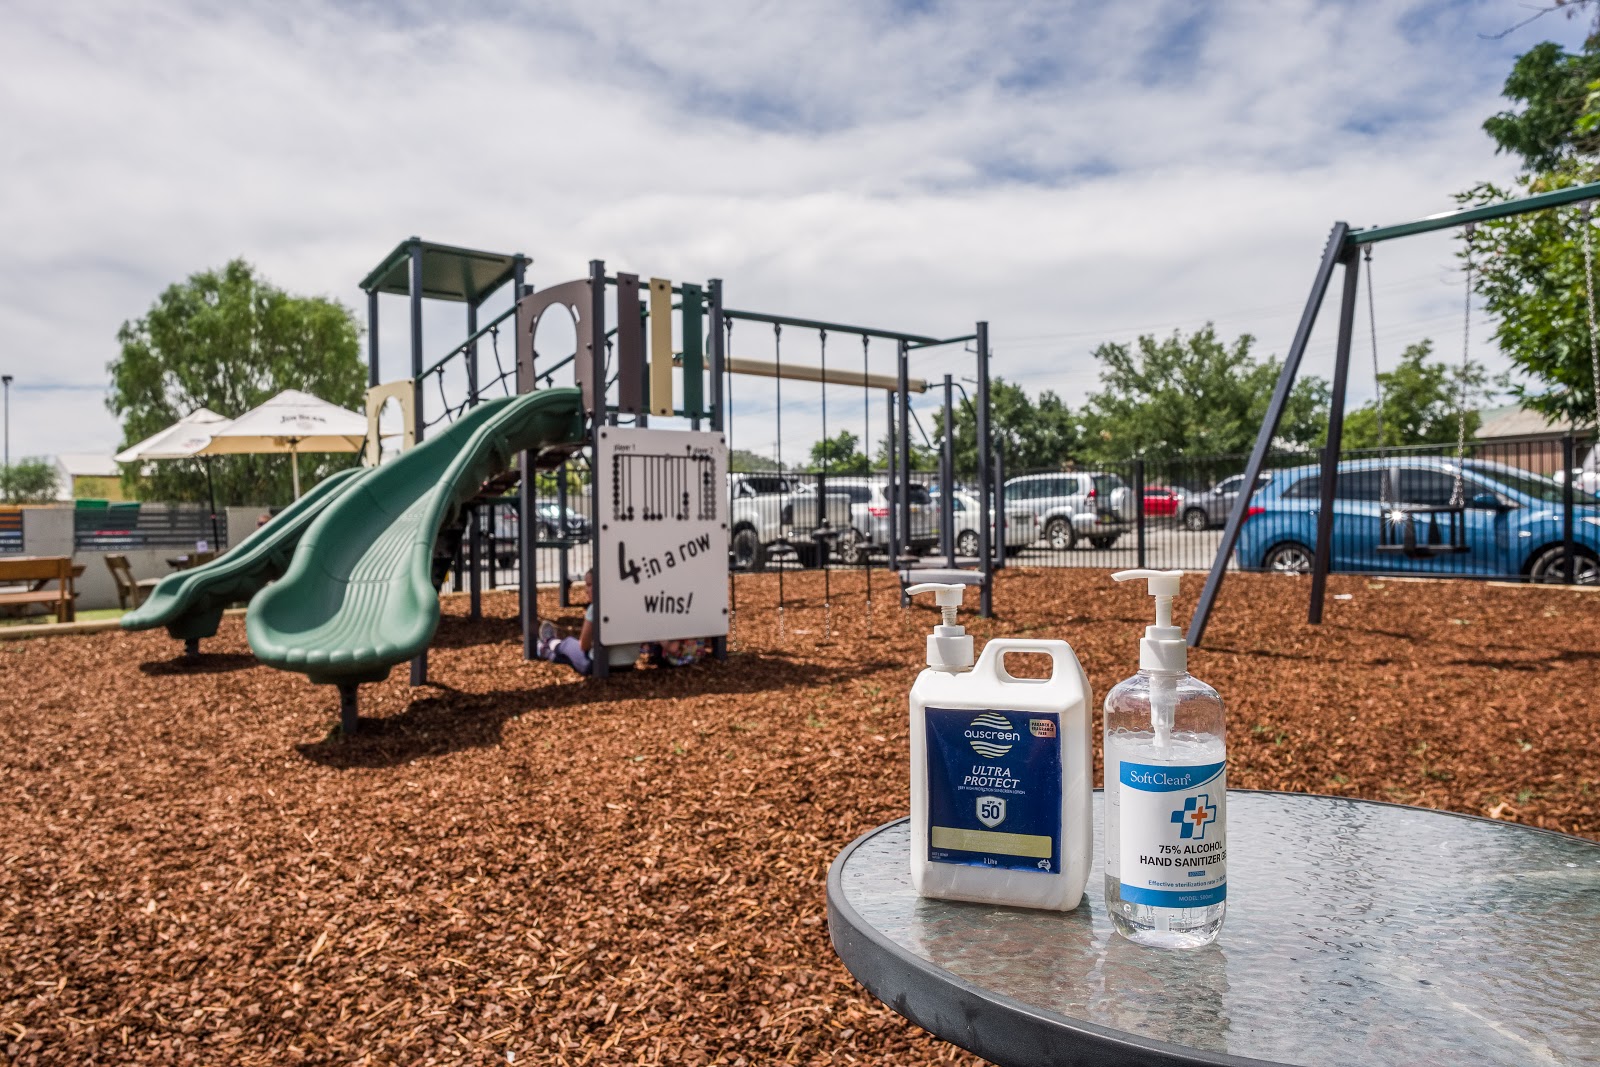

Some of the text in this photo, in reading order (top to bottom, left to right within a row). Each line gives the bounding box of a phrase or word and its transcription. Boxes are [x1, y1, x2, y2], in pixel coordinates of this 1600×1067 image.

[618, 541, 641, 584] 4
[664, 551, 676, 568] a
[679, 533, 711, 562] row
[644, 590, 693, 614] wins!
[964, 730, 1020, 741] auscreen
[972, 765, 1011, 777] ULTRA
[963, 776, 1020, 789] PROTECT
[1159, 841, 1223, 854] 75% ALCOHOL
[1140, 855, 1172, 867] HAND
[1174, 853, 1221, 867] SANITIZER
